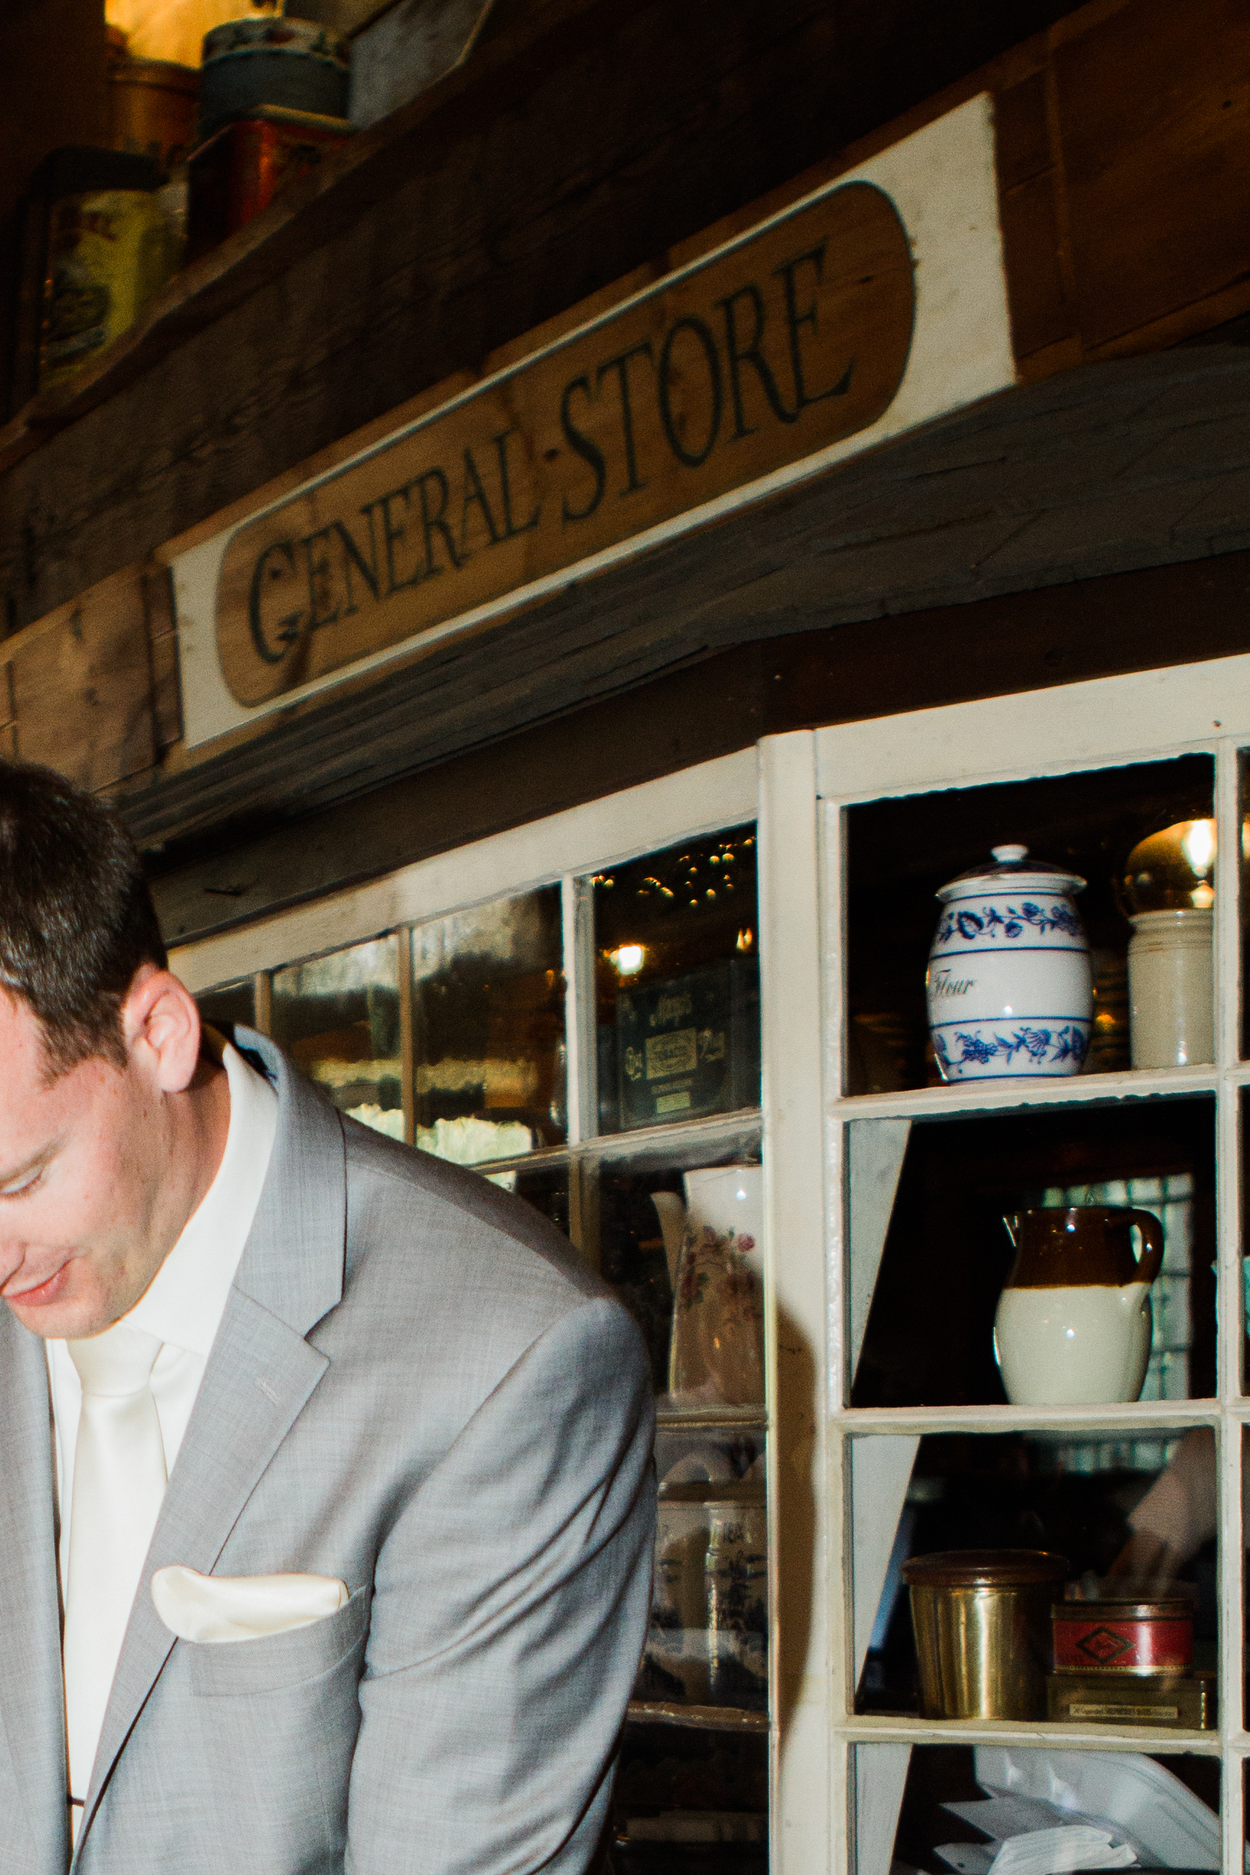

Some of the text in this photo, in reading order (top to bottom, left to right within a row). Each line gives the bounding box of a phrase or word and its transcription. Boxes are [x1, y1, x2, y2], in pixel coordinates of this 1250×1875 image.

[249, 236, 857, 663] GENERAL STORE
[933, 968, 976, 998] Flour
